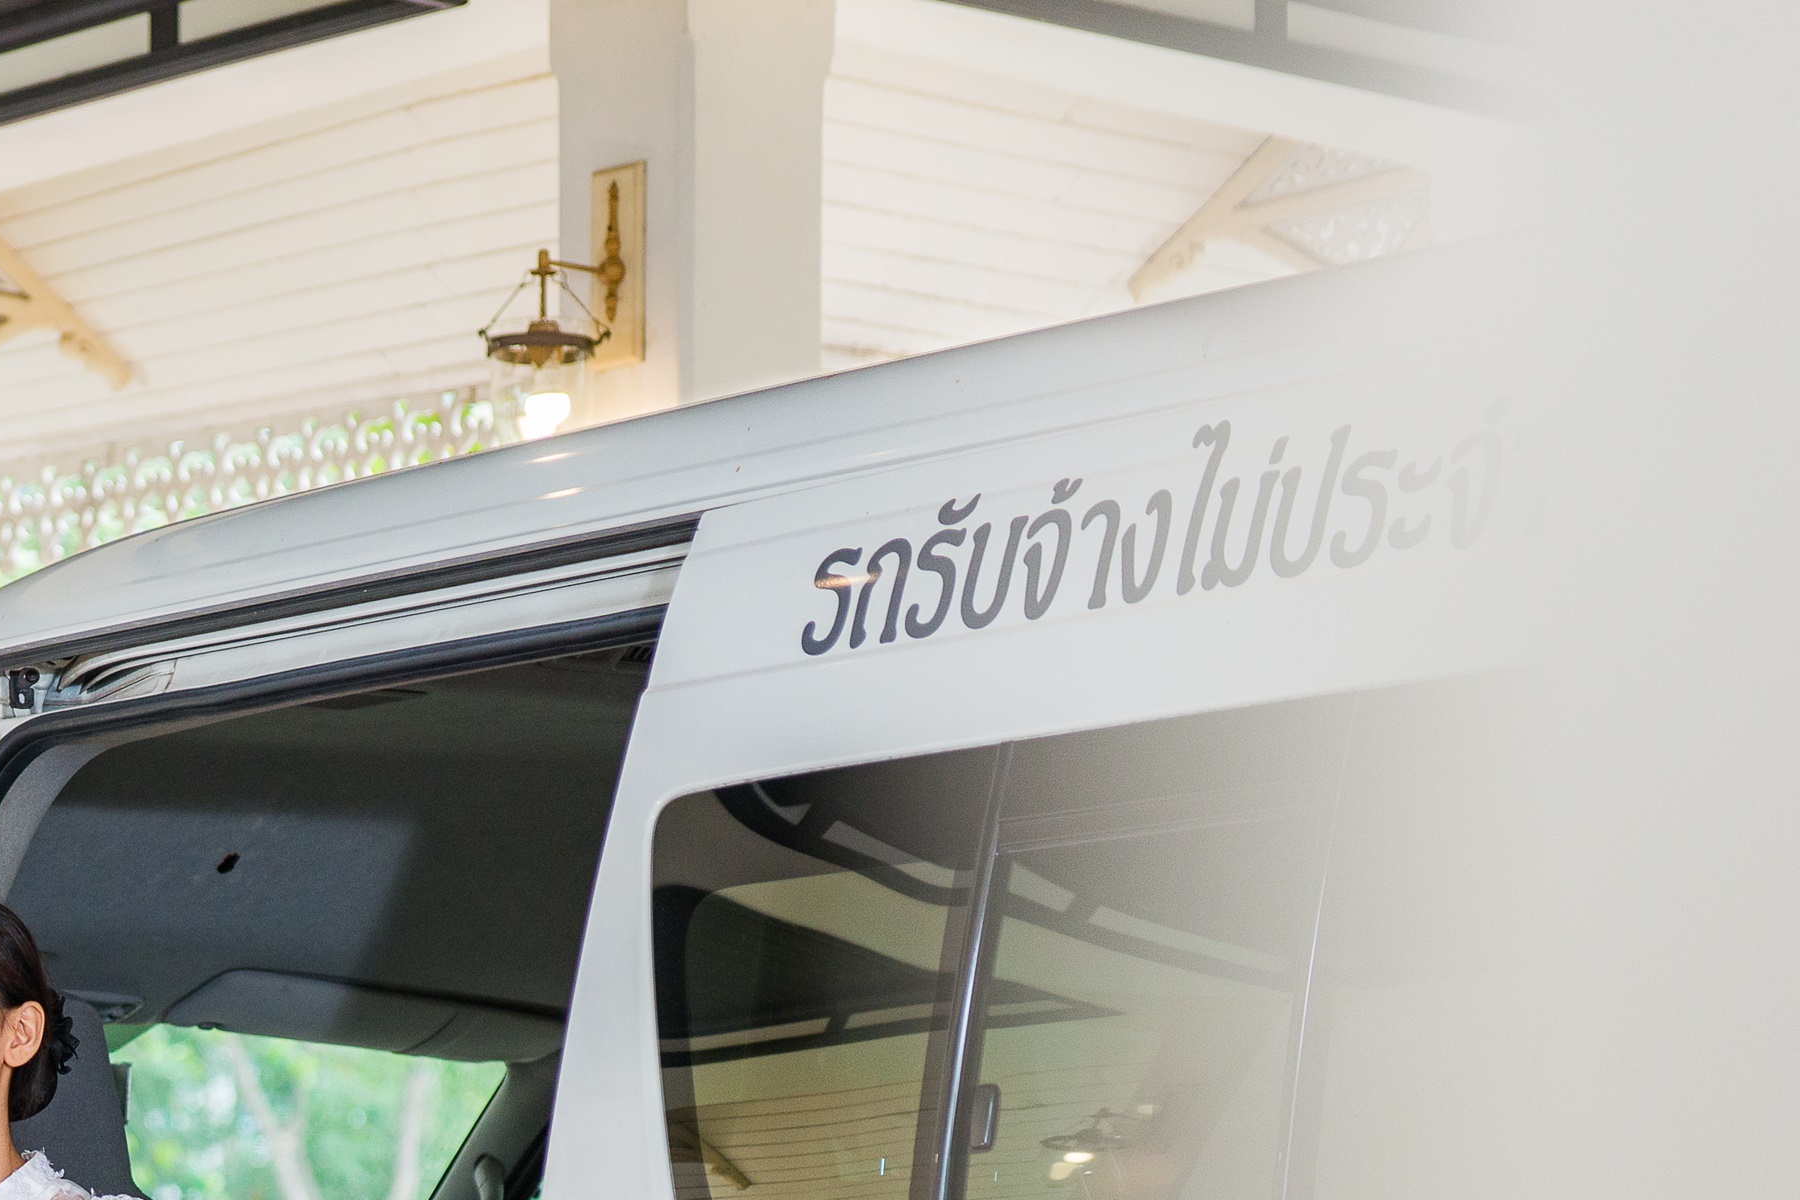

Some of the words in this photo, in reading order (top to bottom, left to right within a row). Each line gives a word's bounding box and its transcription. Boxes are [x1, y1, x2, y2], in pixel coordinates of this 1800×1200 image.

[801, 394, 1511, 656] รถรับจ้างไม่ประจ
